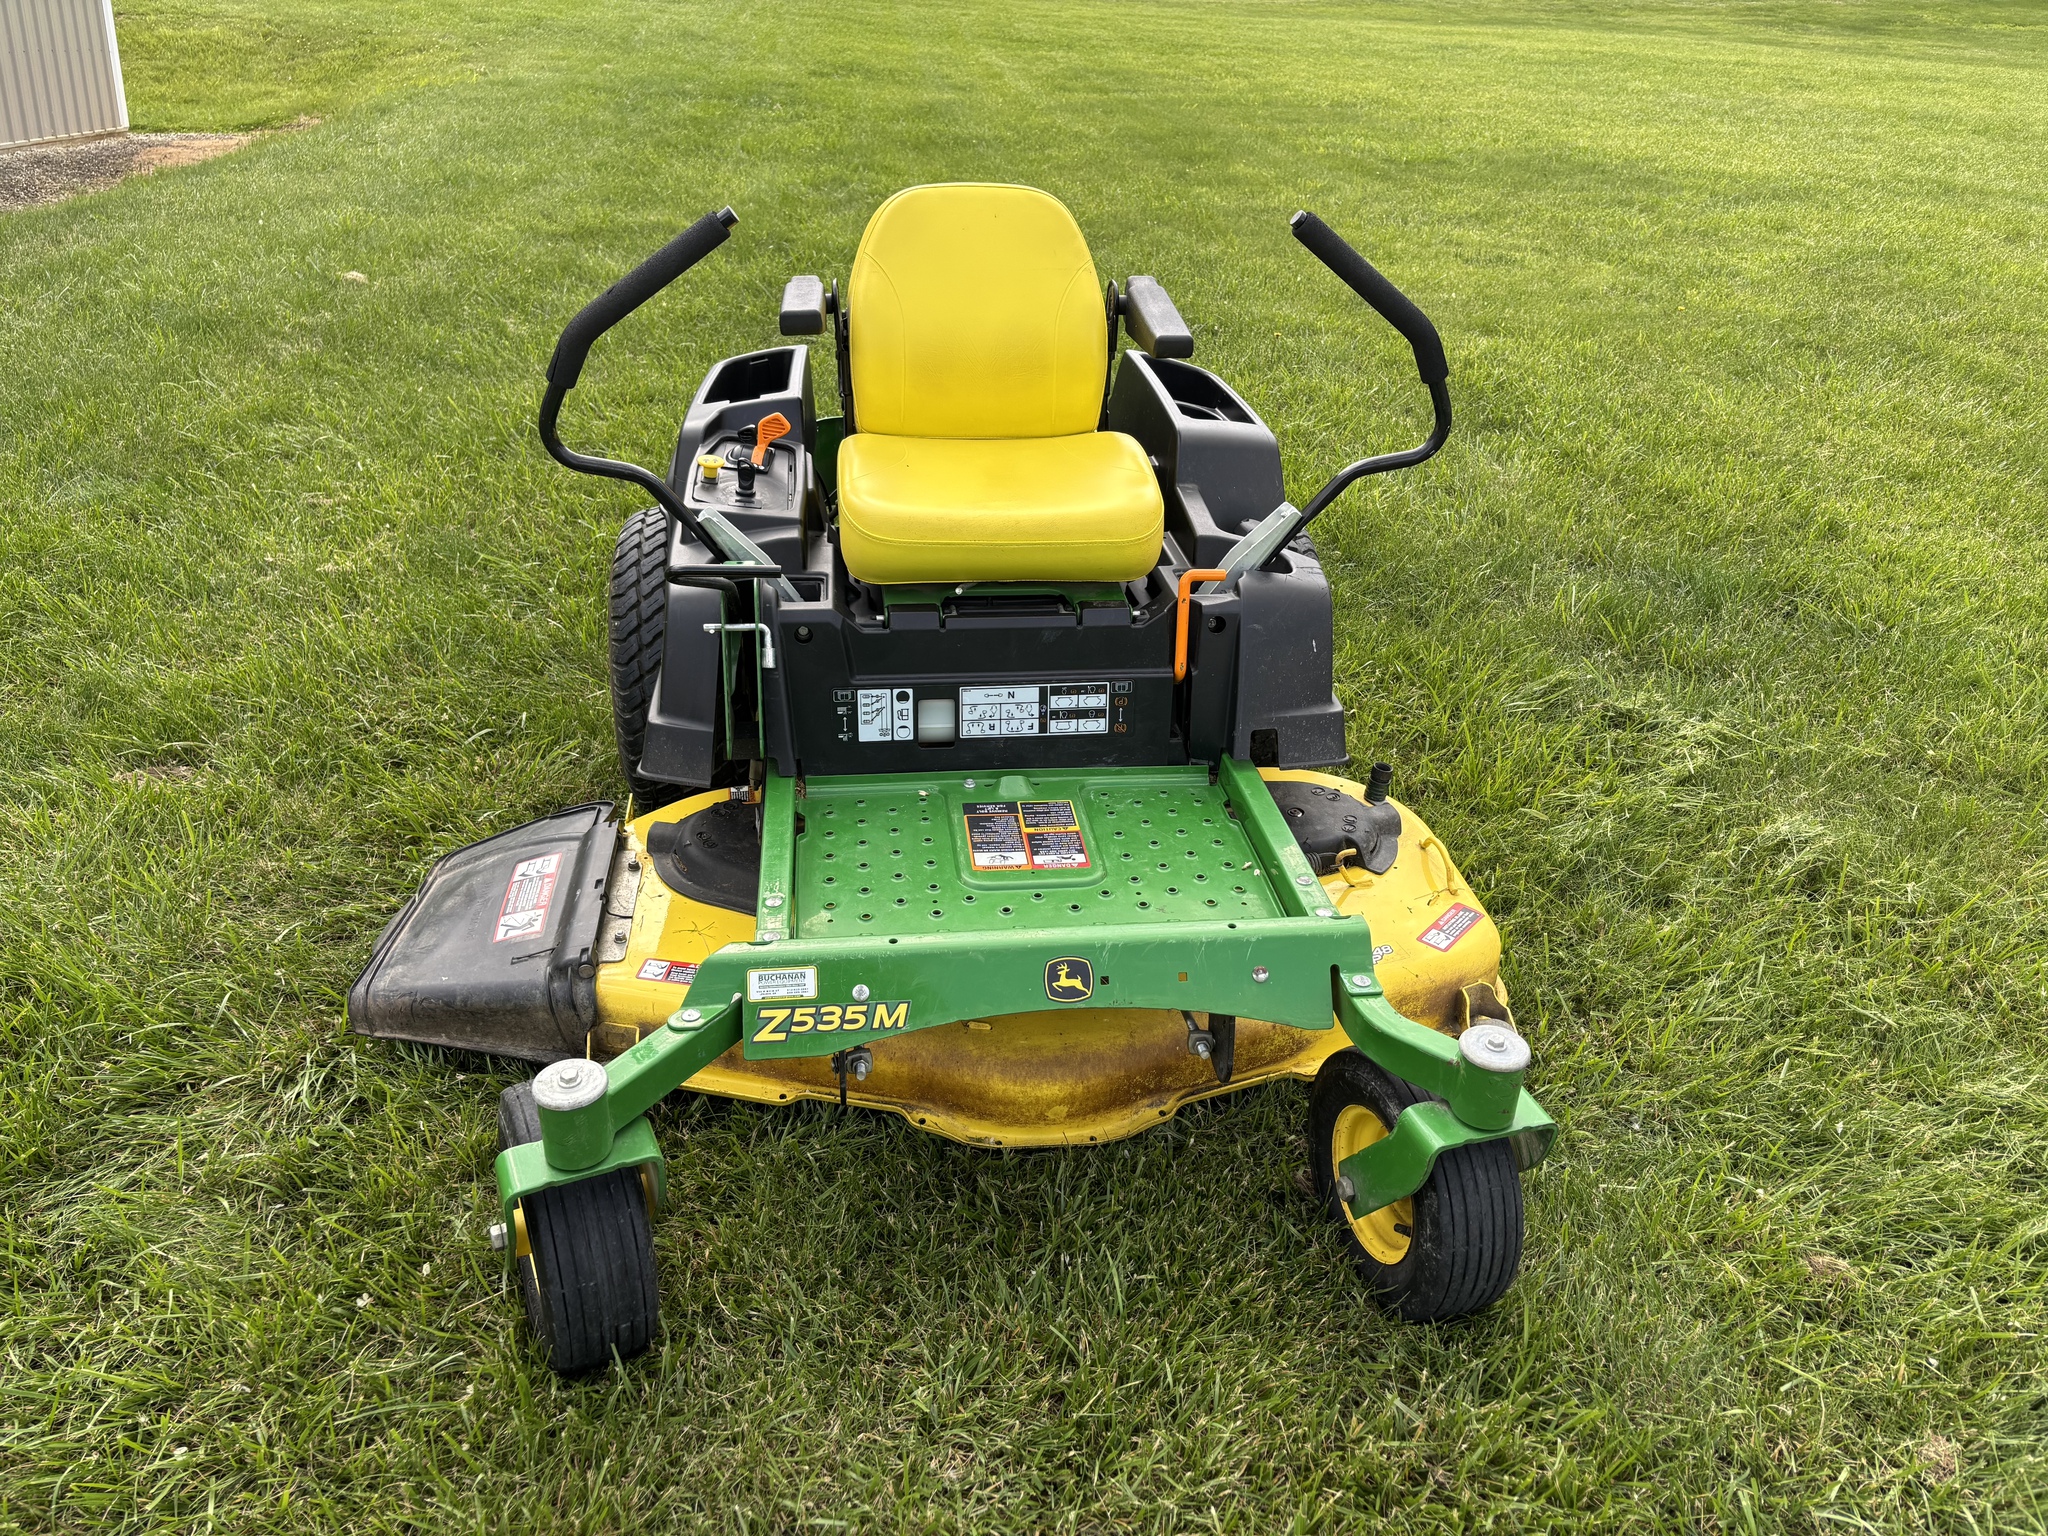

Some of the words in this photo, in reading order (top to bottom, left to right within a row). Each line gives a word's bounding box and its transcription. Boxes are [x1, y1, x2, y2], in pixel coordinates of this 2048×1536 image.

[1007, 691, 1015, 699] N
[988, 723, 995, 731] R
[539, 882, 552, 906] DANGER
[1443, 908, 1457, 923] DANGER
[1372, 945, 1394, 956] 48
[758, 972, 806, 982] BUCHANAN
